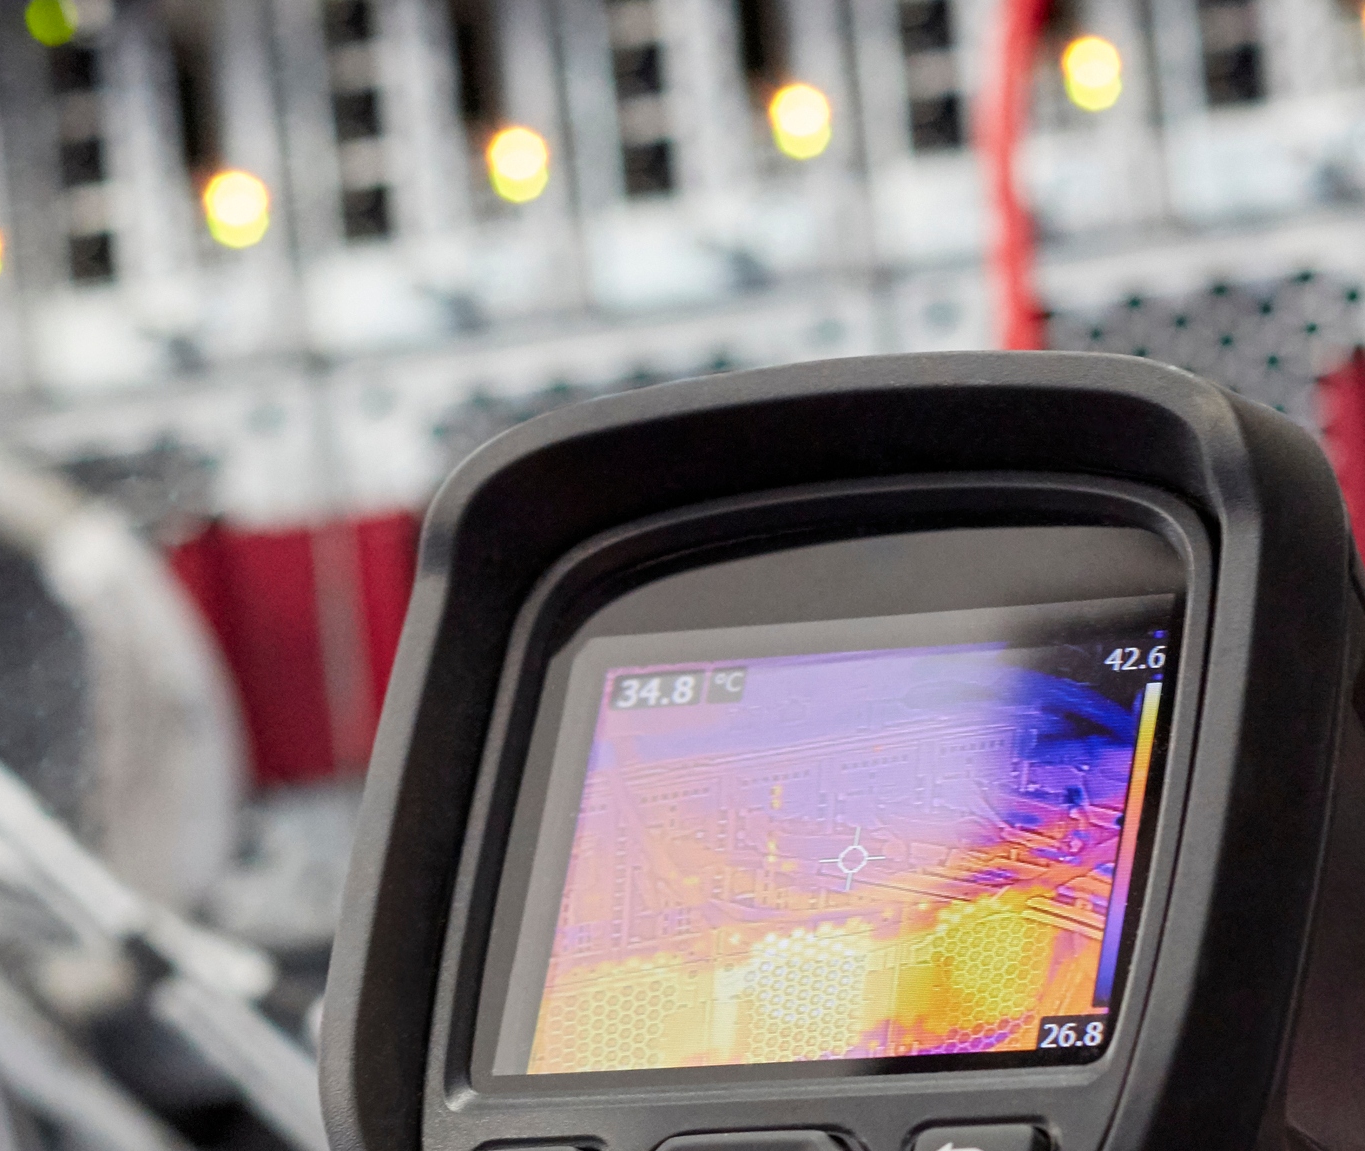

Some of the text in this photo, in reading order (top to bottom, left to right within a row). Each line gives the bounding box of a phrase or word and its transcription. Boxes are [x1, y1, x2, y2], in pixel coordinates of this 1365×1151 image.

[1103, 645, 1168, 672] 42.6
[615, 675, 695, 708] 34.8
[1039, 1021, 1104, 1048] 26.8
